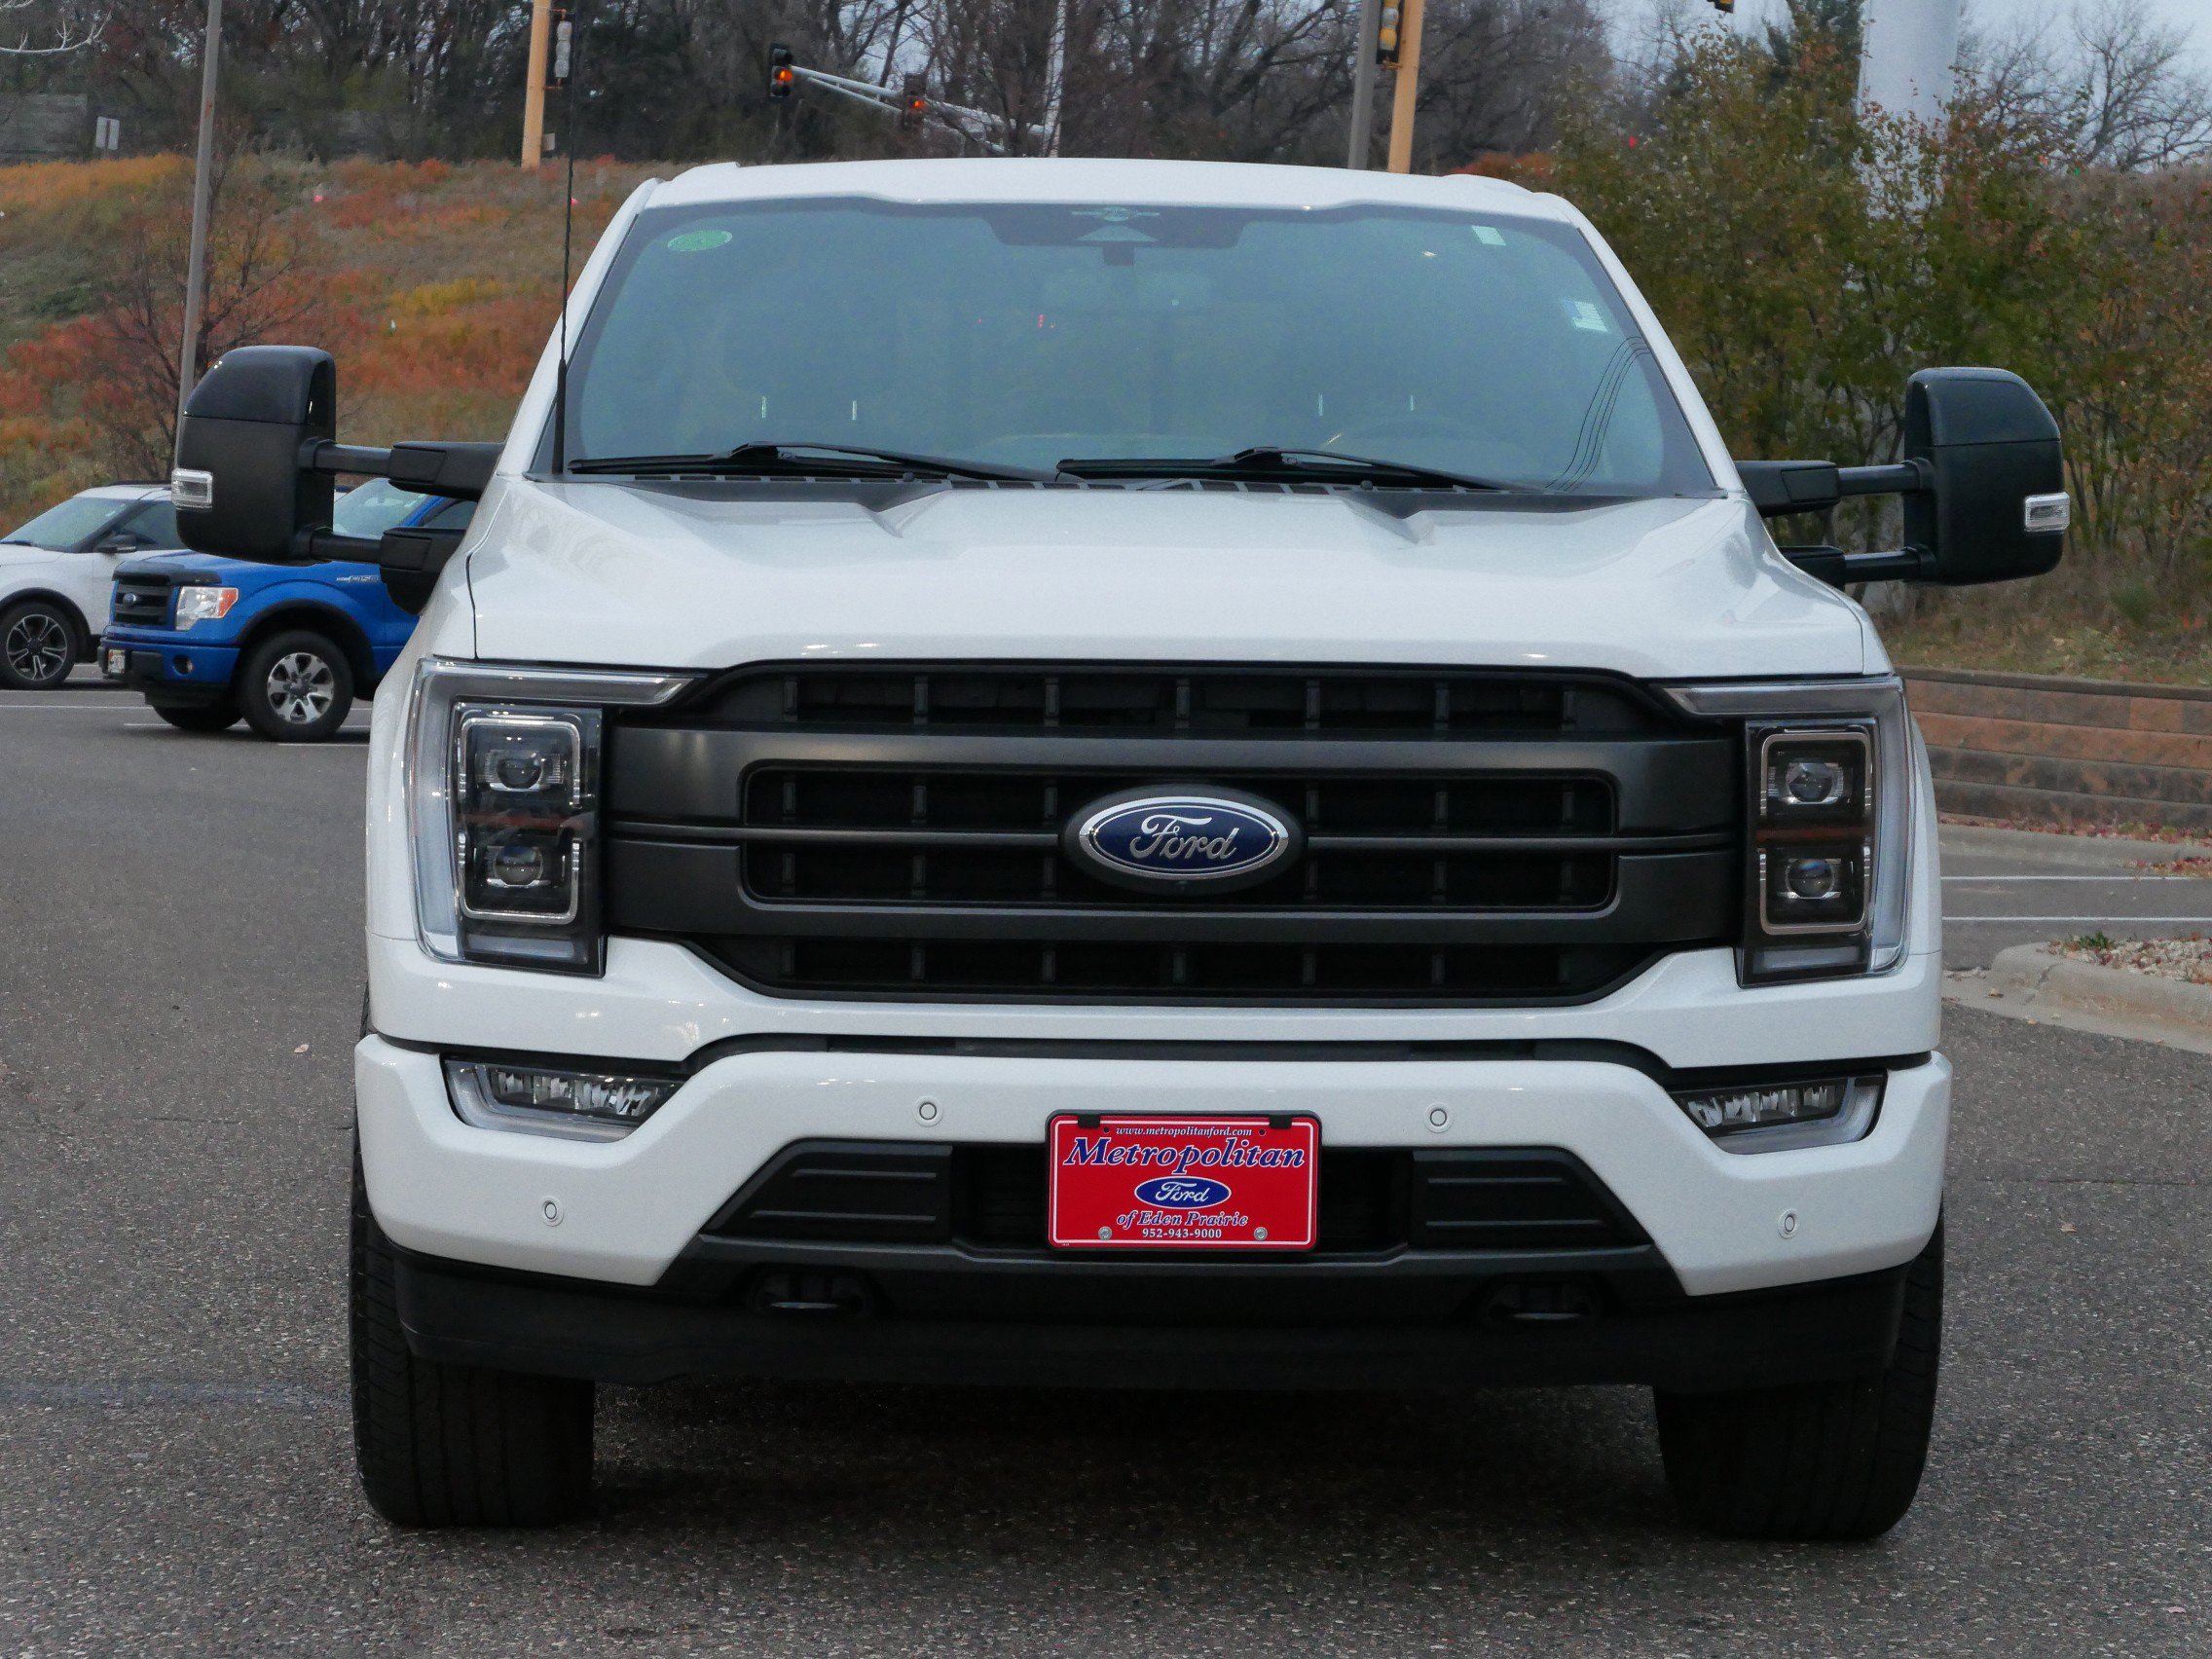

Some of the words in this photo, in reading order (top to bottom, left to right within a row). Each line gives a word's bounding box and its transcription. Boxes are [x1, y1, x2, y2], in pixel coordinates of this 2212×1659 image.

[1129, 814, 1239, 860] Ford
[1116, 1125, 1252, 1137] www.metropolitanford.com
[1063, 1137, 1305, 1174] Metropolitan
[1155, 1181, 1210, 1202] Ford
[1117, 1210, 1138, 1230] of
[1137, 1210, 1182, 1226] Eden
[1185, 1211, 1249, 1227] Prairie
[1142, 1228, 1223, 1238] 952-943-9000
